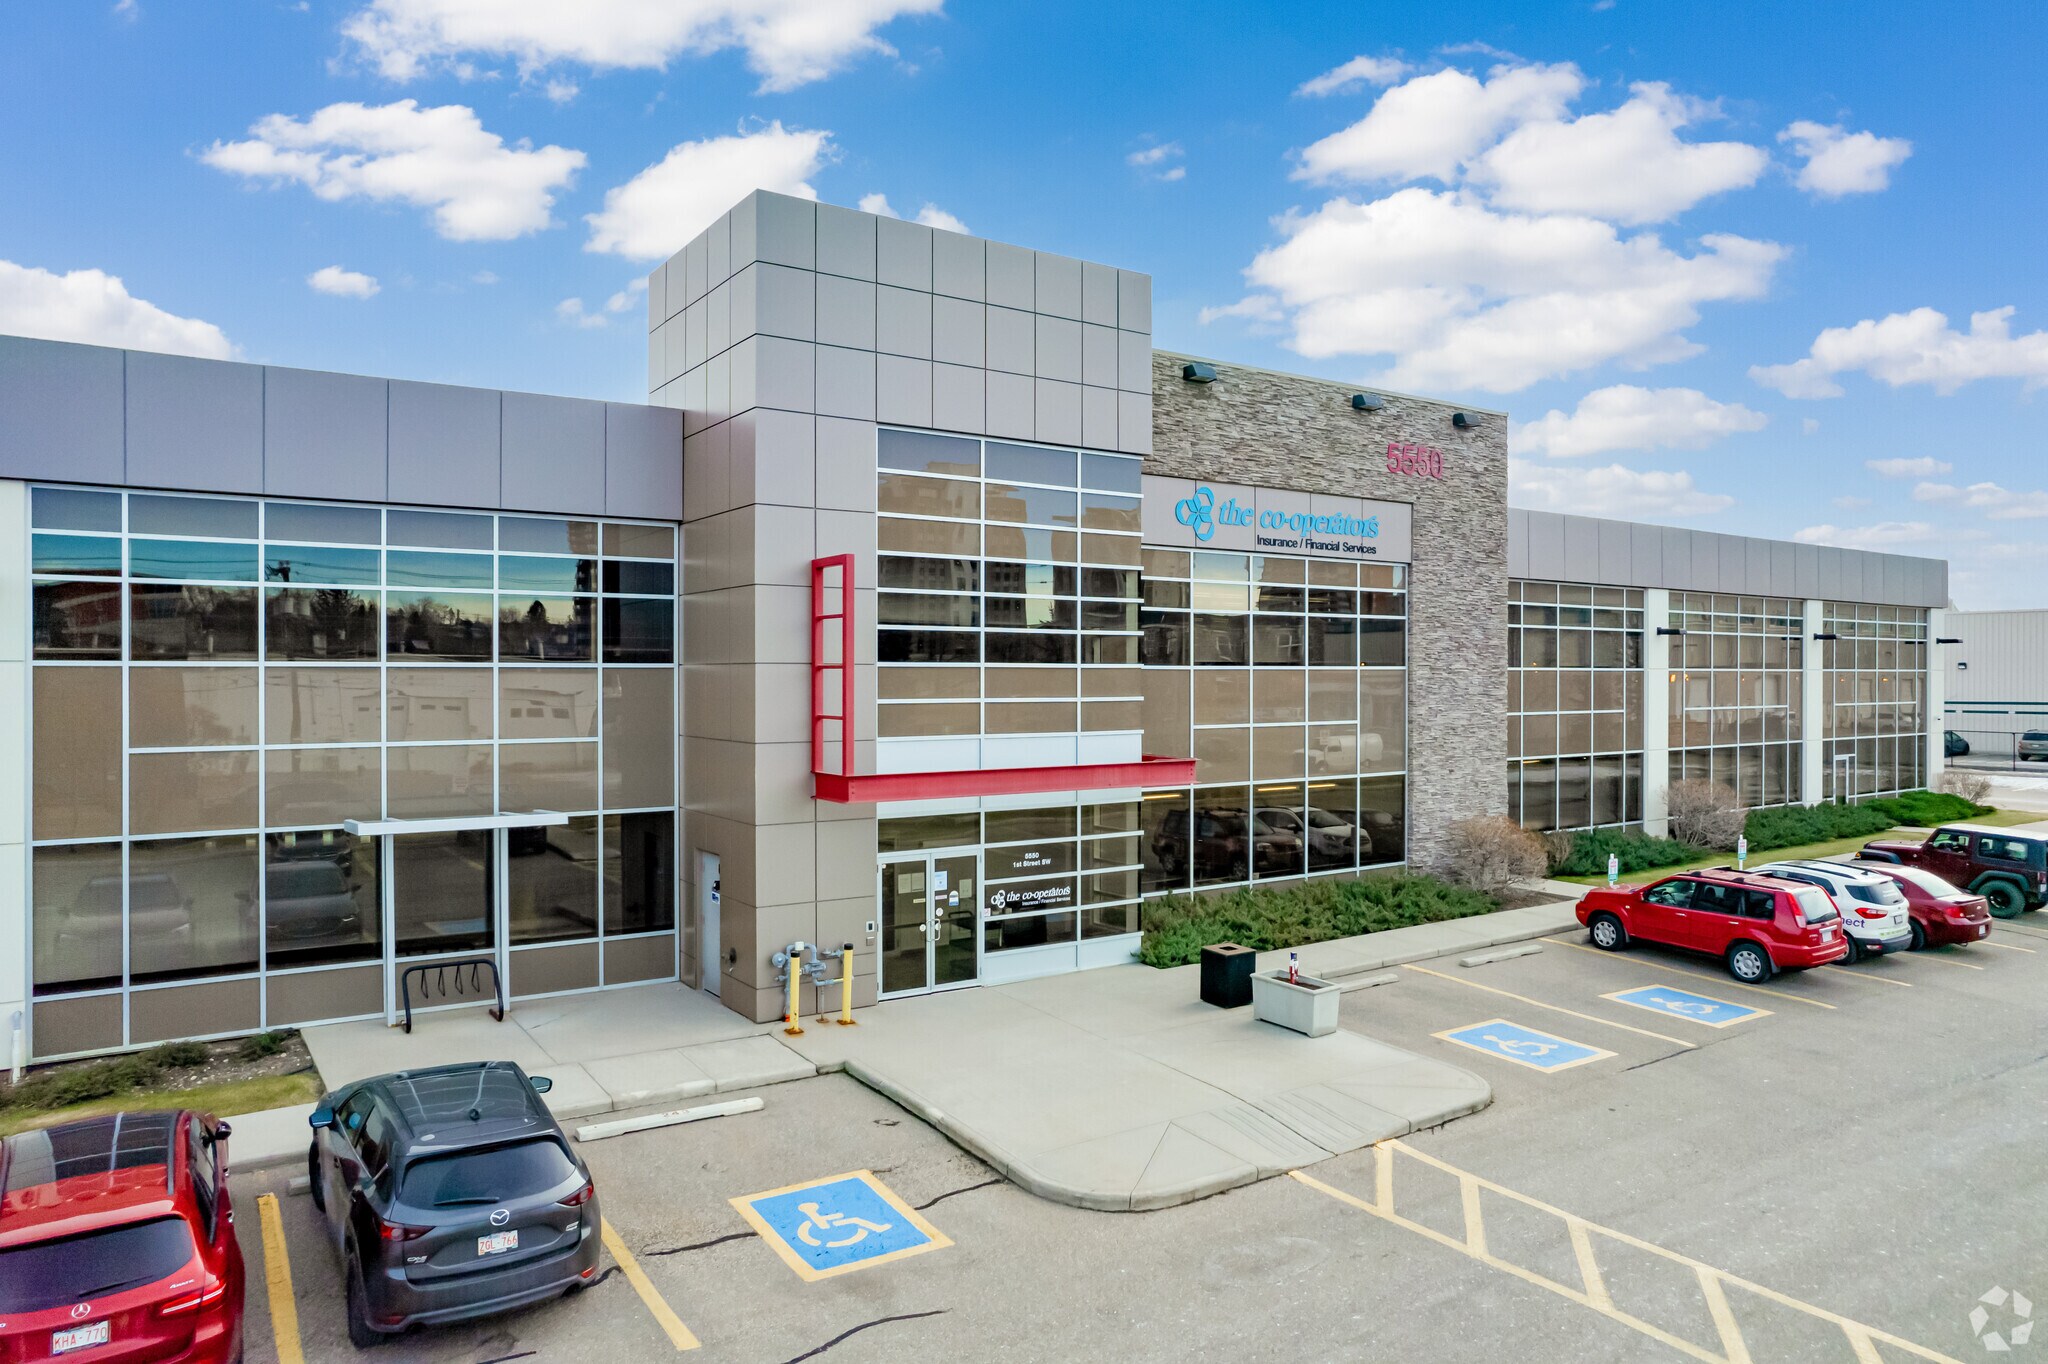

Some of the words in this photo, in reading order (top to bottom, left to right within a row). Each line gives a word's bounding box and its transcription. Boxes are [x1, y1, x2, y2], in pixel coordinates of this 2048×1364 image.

[1386, 442, 1444, 479] 5550
[1219, 497, 1254, 527] the
[1260, 507, 1380, 538] co-operators
[1257, 534, 1298, 549] Insurance
[1305, 538, 1340, 552] Financial
[1342, 541, 1377, 555] Services
[1023, 859, 1041, 867] Street
[1041, 858, 1052, 866] SW
[1006, 892, 1021, 902] the
[1022, 886, 1071, 901] co-operators
